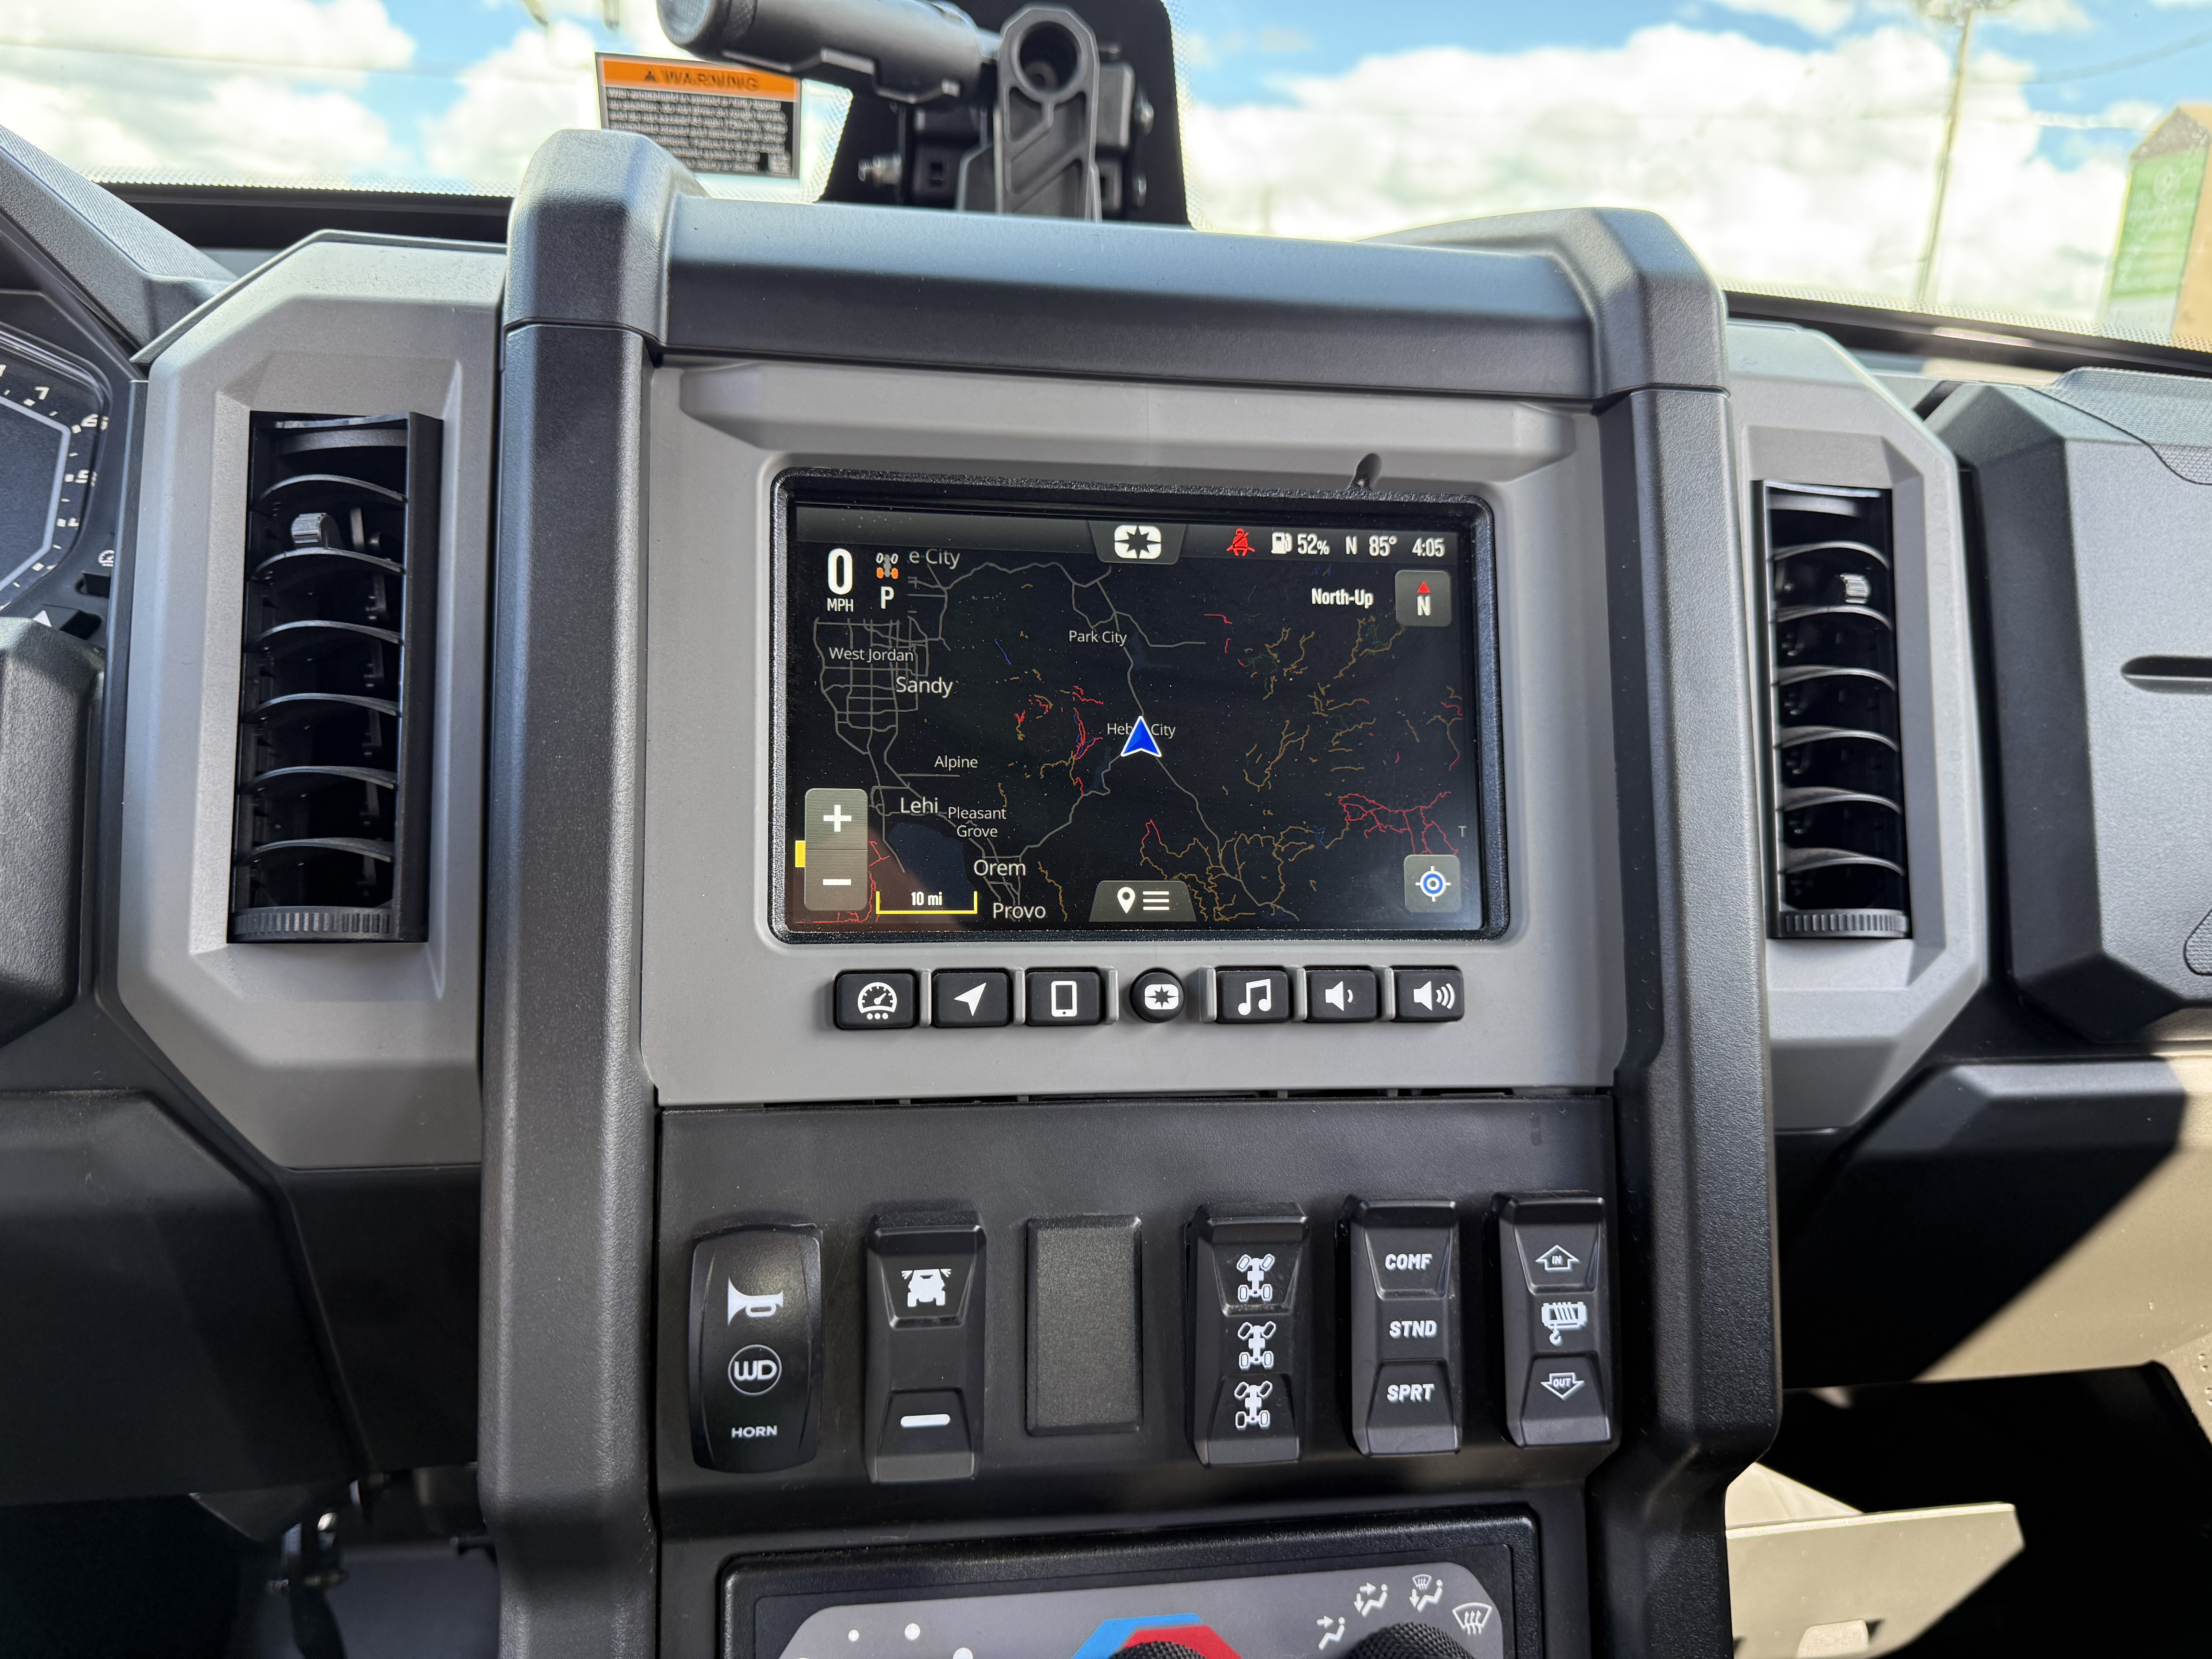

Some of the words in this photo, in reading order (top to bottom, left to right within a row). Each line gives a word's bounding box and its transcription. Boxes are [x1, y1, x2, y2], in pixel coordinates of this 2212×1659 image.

[662, 70, 760, 91] WARNING
[1297, 533, 1330, 555] 52%
[1345, 535, 1357, 555] N
[1369, 535, 1398, 556] 85°
[1412, 537, 1445, 557] 4:05
[926, 550, 960, 570] City
[828, 548, 853, 595] 0
[827, 598, 854, 612] MPH
[881, 586, 894, 609] P
[1311, 587, 1374, 609] North-Up
[1417, 595, 1431, 616] N
[1069, 630, 1098, 642] Park
[1102, 631, 1127, 647] City
[829, 647, 865, 660] West
[866, 648, 913, 663] Jordan
[896, 676, 953, 698] Sandy
[1106, 722, 1133, 735] Heb
[1150, 724, 1176, 740] City
[934, 755, 978, 771] Alpine
[901, 797, 938, 813] Lehi
[948, 806, 1006, 819] Pleasant
[957, 825, 998, 837] Grove
[974, 859, 1025, 876] Orem
[911, 891, 924, 906] 10
[927, 891, 942, 906] mi
[993, 902, 1046, 919] Provo
[1385, 1254, 1432, 1270] COMF
[1552, 1255, 1562, 1264] IN
[1389, 1320, 1437, 1338] STND
[733, 1360, 777, 1381] WD
[1553, 1377, 1571, 1388] OUT
[1387, 1383, 1434, 1401] SPRT
[732, 1425, 777, 1437] HORN
